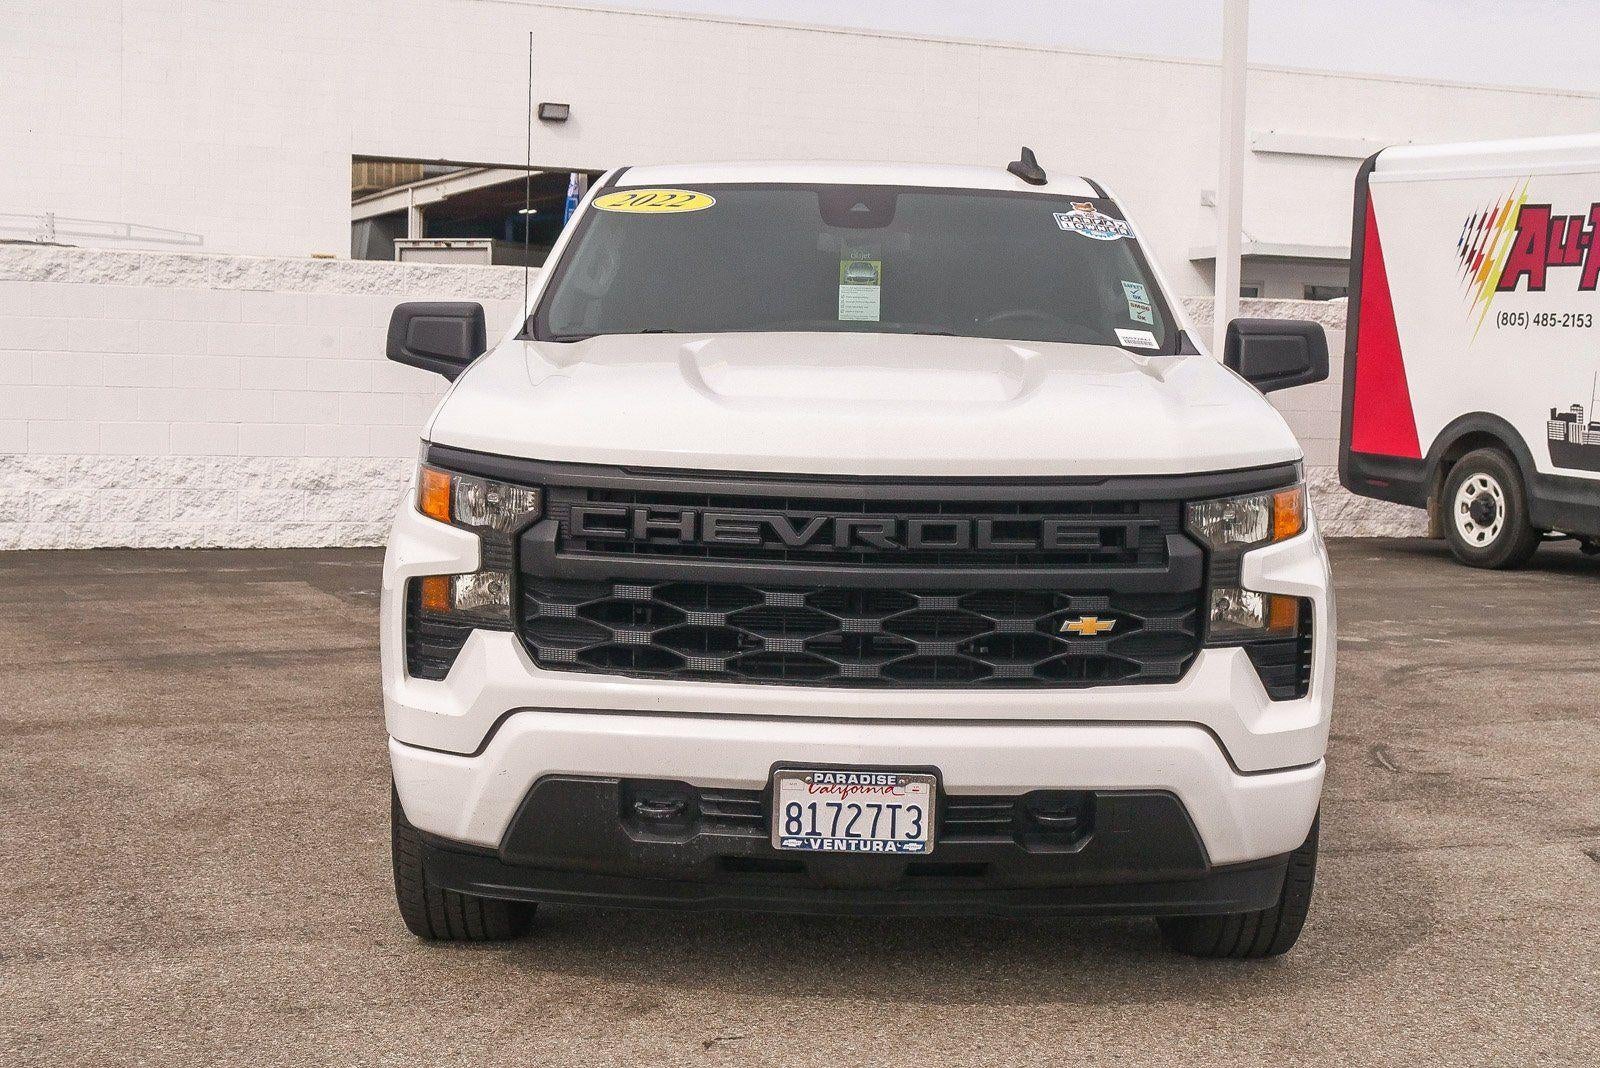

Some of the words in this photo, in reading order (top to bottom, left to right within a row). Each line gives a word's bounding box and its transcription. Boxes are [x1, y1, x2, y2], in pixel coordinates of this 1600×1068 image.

[607, 193, 696, 208] 2022
[1123, 282, 1143, 290] SAFETY
[1130, 302, 1151, 311] SMOG
[1496, 311, 1529, 329] (805)
[1533, 313, 1593, 328] 485-2153
[570, 505, 1160, 549] CHEVROLET
[814, 773, 897, 785] PARADISE
[808, 783, 905, 800] California
[785, 801, 922, 839] 81727T3
[810, 838, 897, 852] VENTURA
